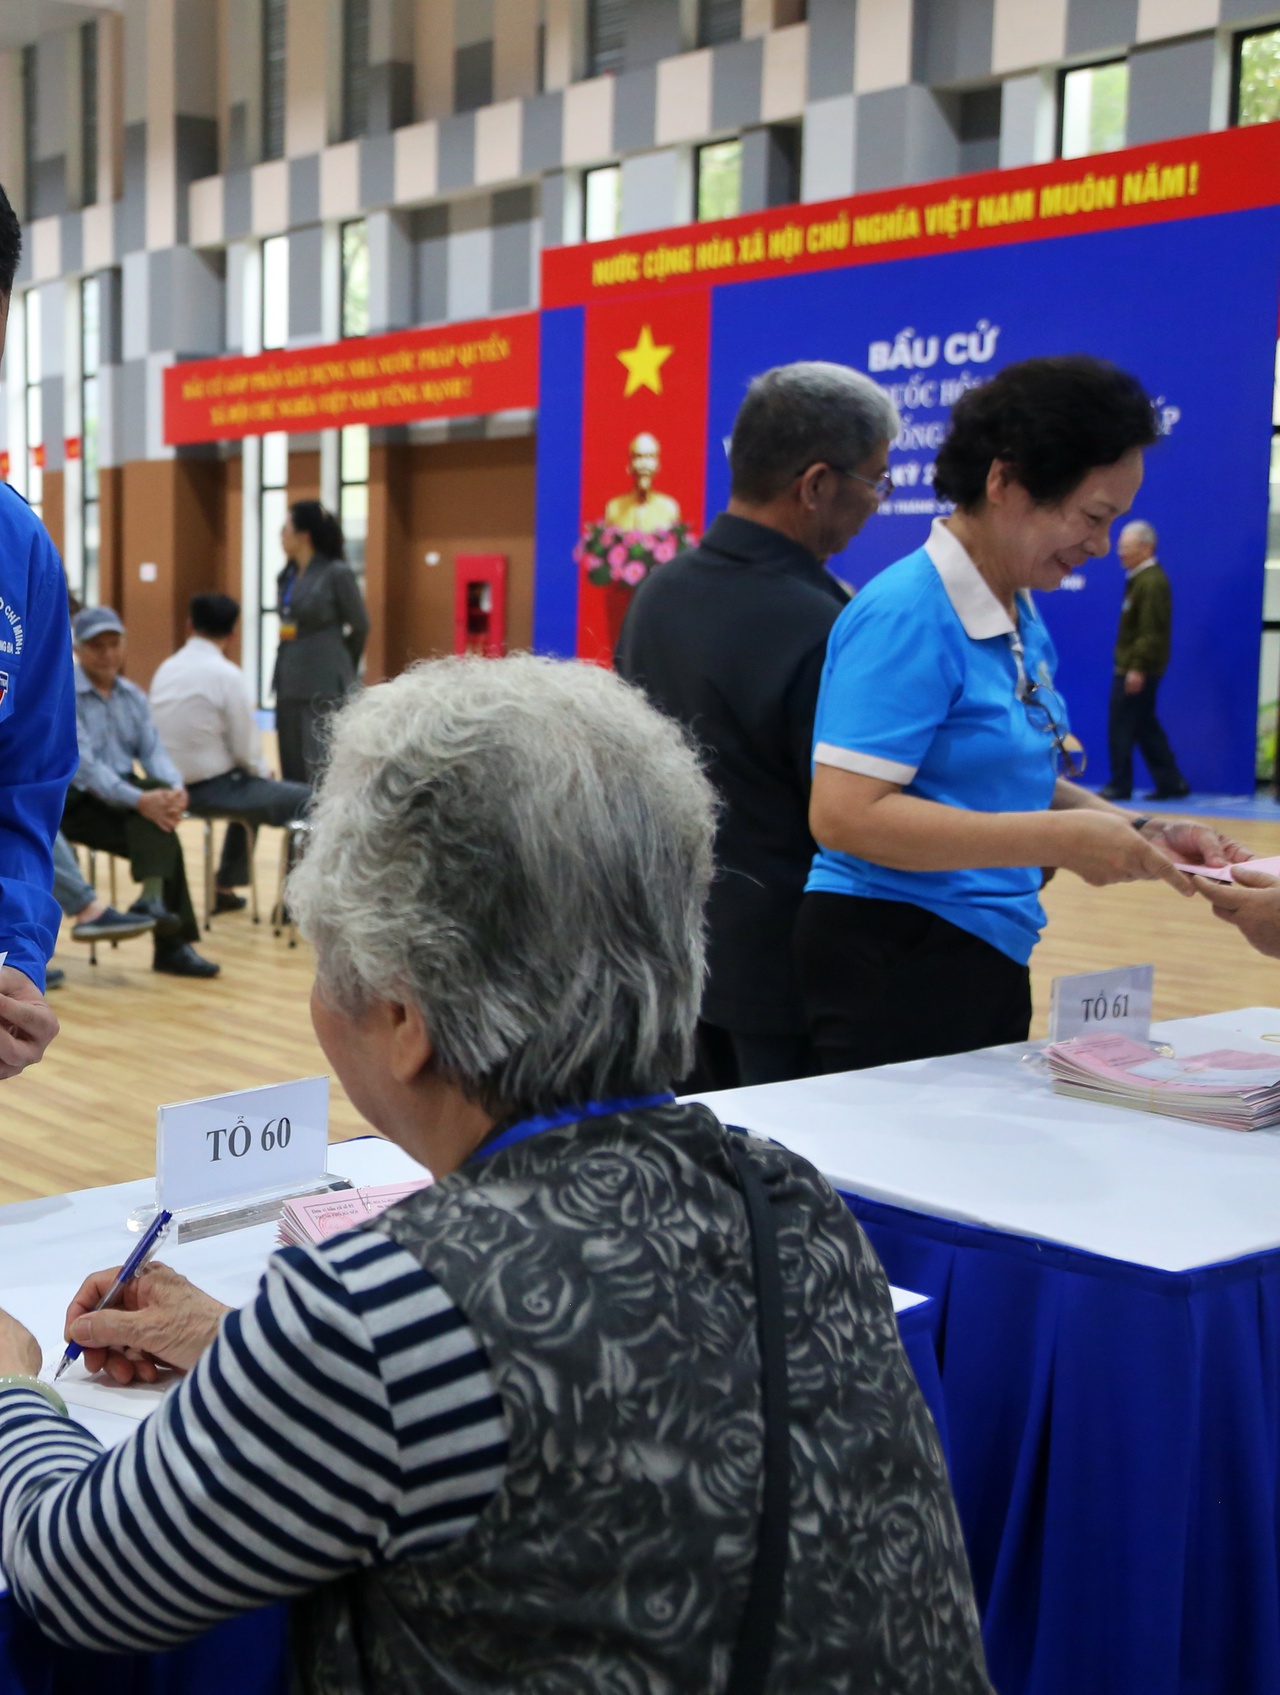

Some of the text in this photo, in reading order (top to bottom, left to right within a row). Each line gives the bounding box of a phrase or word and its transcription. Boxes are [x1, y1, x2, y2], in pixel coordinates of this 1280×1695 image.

[592, 252, 640, 286] NƯỚC
[643, 244, 693, 282] CỘNG
[737, 229, 765, 264] XÃ
[767, 222, 804, 263] HỘI
[806, 210, 850, 253] CHỦ
[852, 203, 919, 246] NGHĨA
[924, 194, 973, 239] VIỆT
[977, 188, 1036, 228] NAM
[1039, 172, 1117, 219] MUÔN
[944, 319, 1000, 366] CỬ
[4, 605, 21, 625] CHÍ
[12, 624, 24, 655] MINH
[1081, 989, 1130, 1023] TỔ 61
[206, 1116, 292, 1162] TỔ 60
